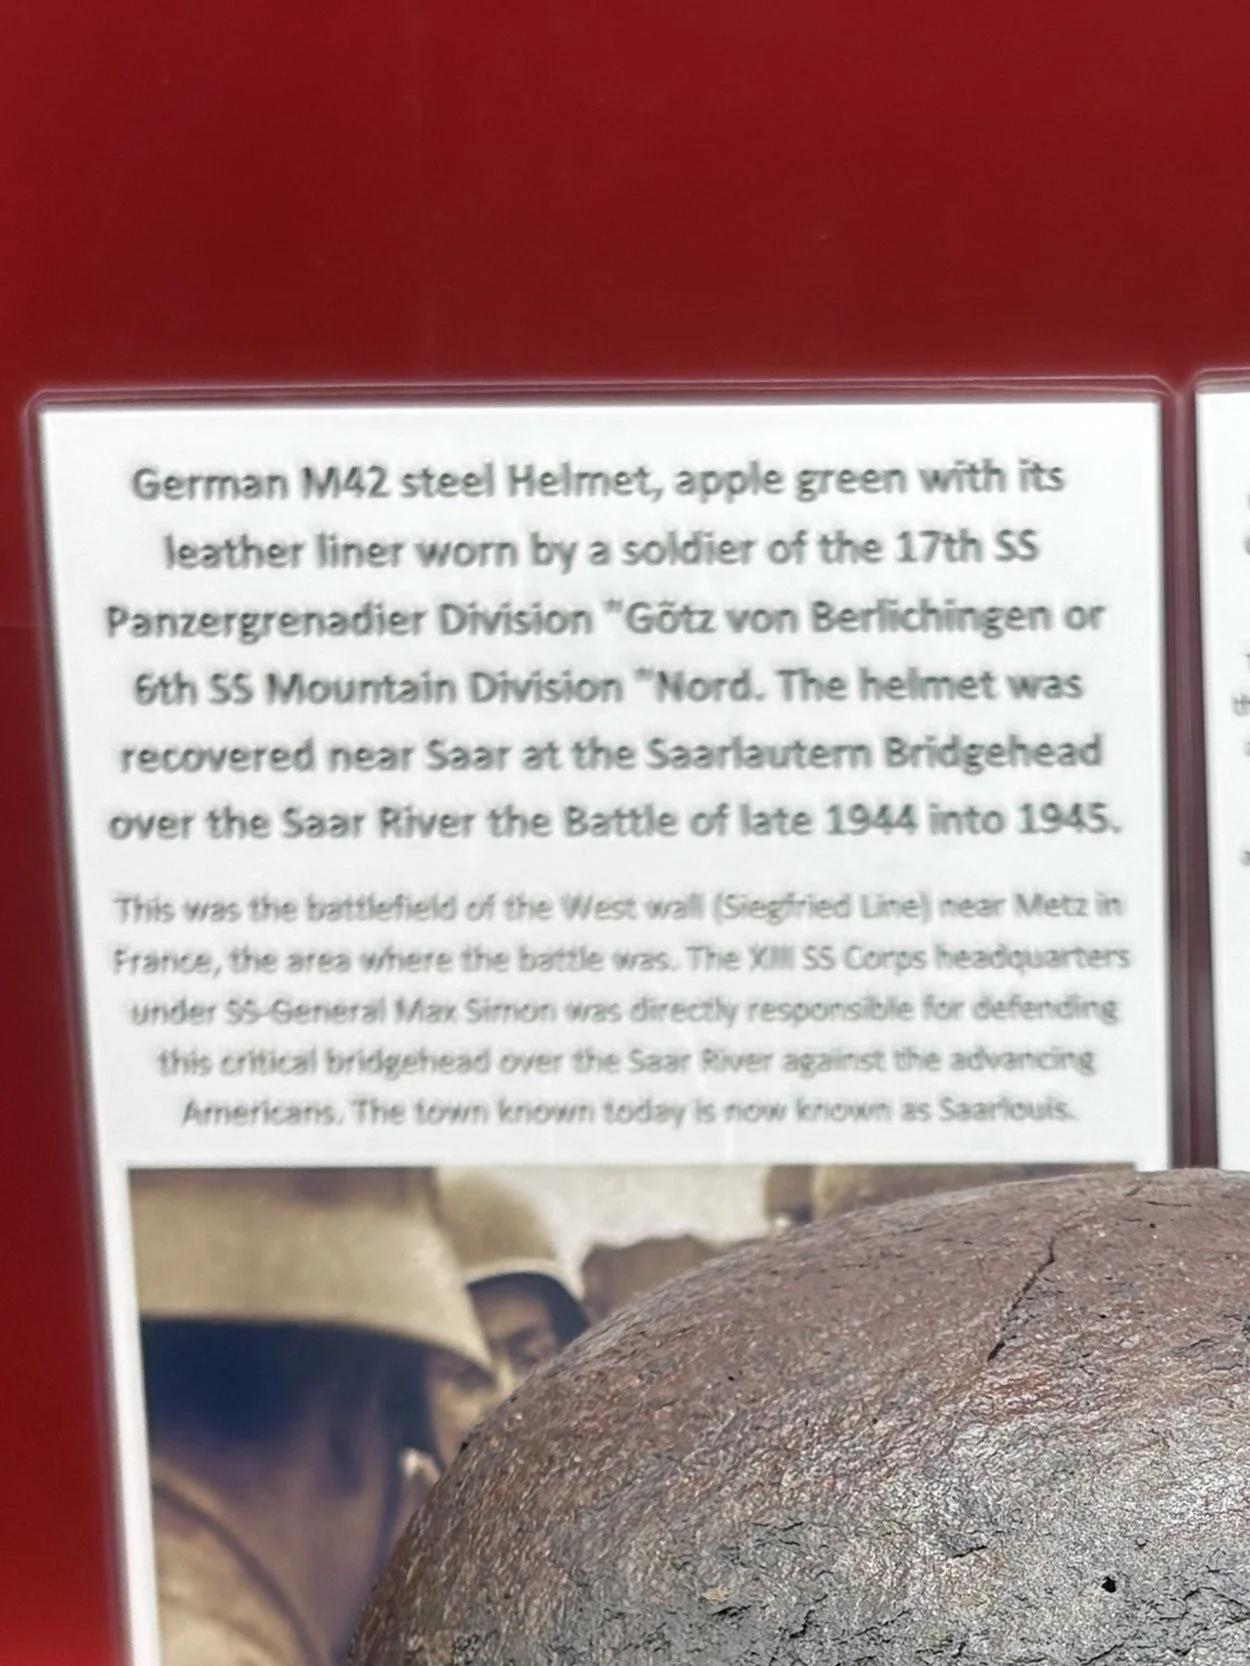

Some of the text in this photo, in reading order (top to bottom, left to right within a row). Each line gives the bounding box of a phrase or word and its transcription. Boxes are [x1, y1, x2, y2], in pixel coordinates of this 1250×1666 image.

[129, 457, 1066, 504] German M42 steel Helmet, apple green with its
[162, 527, 1041, 574] leather liner worn by a soldier of the 17th SS
[103, 599, 428, 647] Panzergrenadier
[436, 599, 594, 636] Division
[723, 607, 800, 633] von
[809, 596, 1053, 642] Berlichingen
[1062, 603, 1107, 630] or
[132, 670, 199, 706] 6th
[207, 670, 255, 705] SS
[264, 669, 458, 705] Mountain
[467, 667, 625, 704] Division
[774, 666, 849, 701] The
[857, 665, 998, 701] helmet
[1005, 673, 1085, 700] was
[119, 731, 1104, 776] recovered near Saar at the Saarlautern Bridgehead
[106, 800, 1122, 840] over the Saar River the Battle of late 1944 into 1945.
[111, 892, 177, 924] This
[180, 899, 243, 923] was
[246, 891, 299, 923] the
[303, 890, 459, 922] battlefield
[464, 892, 497, 921] of
[502, 891, 554, 921] the
[558, 892, 638, 920] West
[642, 890, 706, 920] wall
[937, 896, 1007, 919] near
[1012, 890, 1090, 918] Metz
[1094, 890, 1126, 916] in
[348, 1095, 407, 1126] The
[412, 1097, 491, 1125] town
[495, 1095, 597, 1125] known
[600, 1096, 688, 1128] today
[692, 1097, 718, 1124] is
[722, 1101, 789, 1123] now
[793, 1095, 893, 1123] known
[900, 1101, 933, 1122] as
